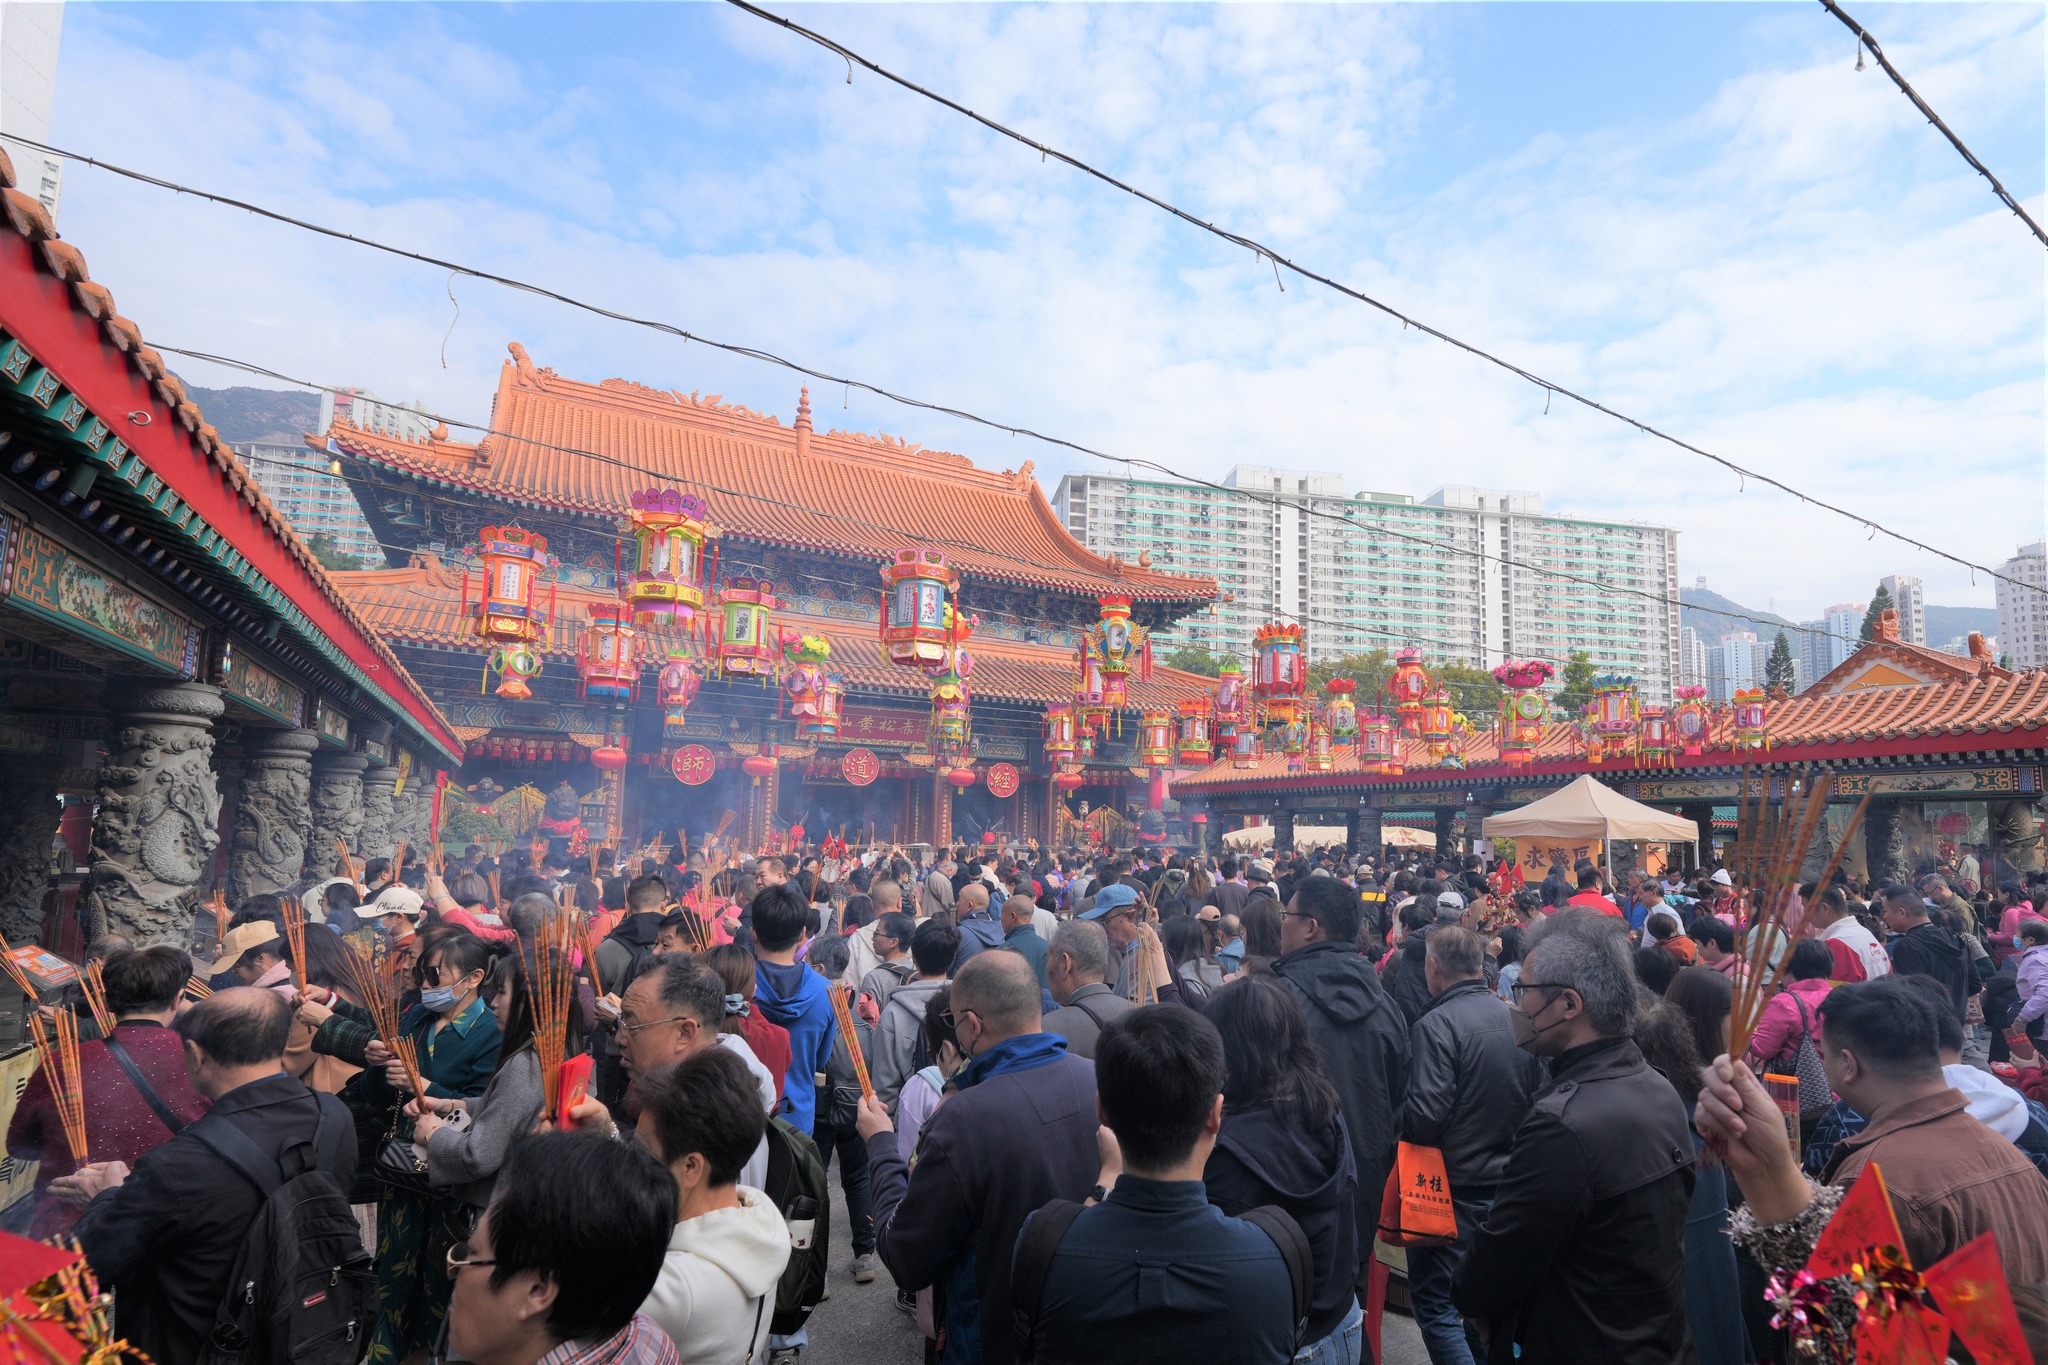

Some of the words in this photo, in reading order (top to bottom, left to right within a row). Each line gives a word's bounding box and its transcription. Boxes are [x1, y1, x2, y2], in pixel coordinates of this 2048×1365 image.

[682, 753, 704, 776] 師
[849, 755, 870, 778] 道
[993, 771, 1010, 789] 經
